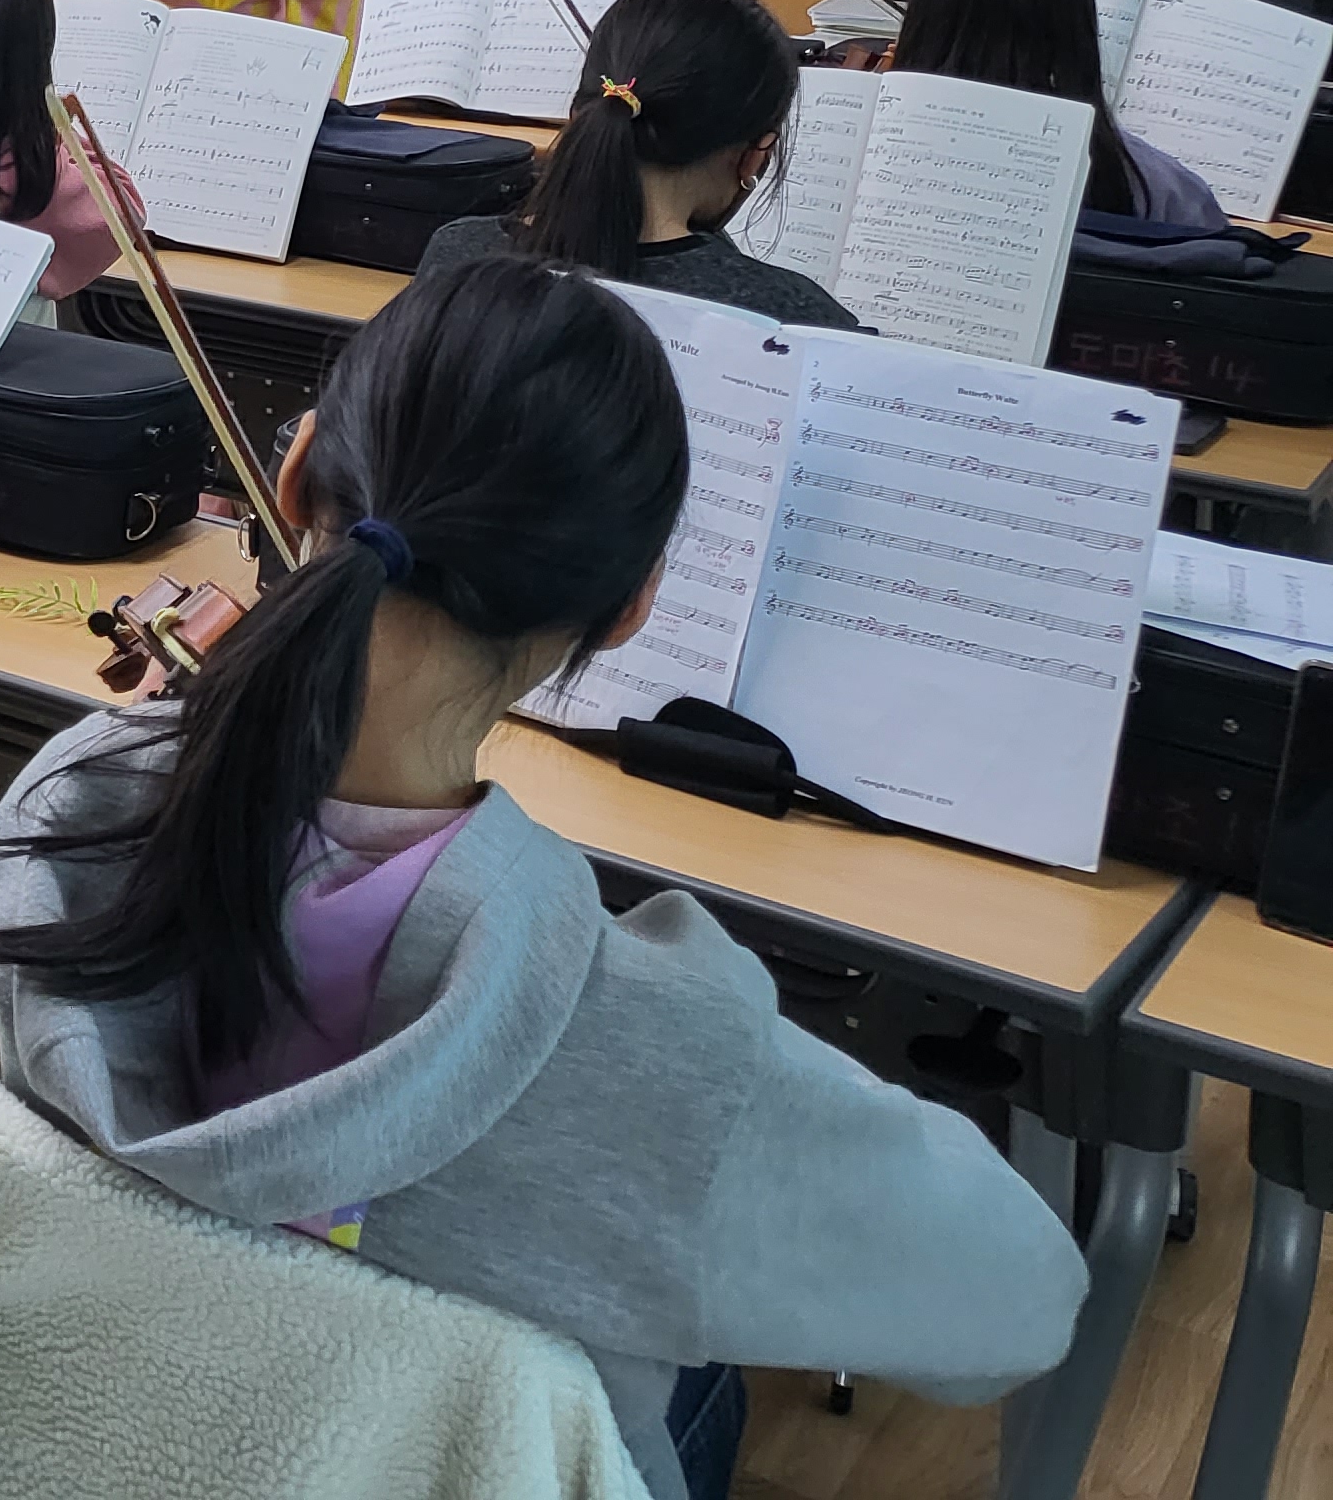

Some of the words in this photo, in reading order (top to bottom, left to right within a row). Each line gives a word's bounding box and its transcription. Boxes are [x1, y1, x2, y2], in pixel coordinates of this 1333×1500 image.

[669, 338, 700, 357] Waltz
[957, 387, 993, 401] Butterfly
[994, 393, 1019, 404] Waltz
